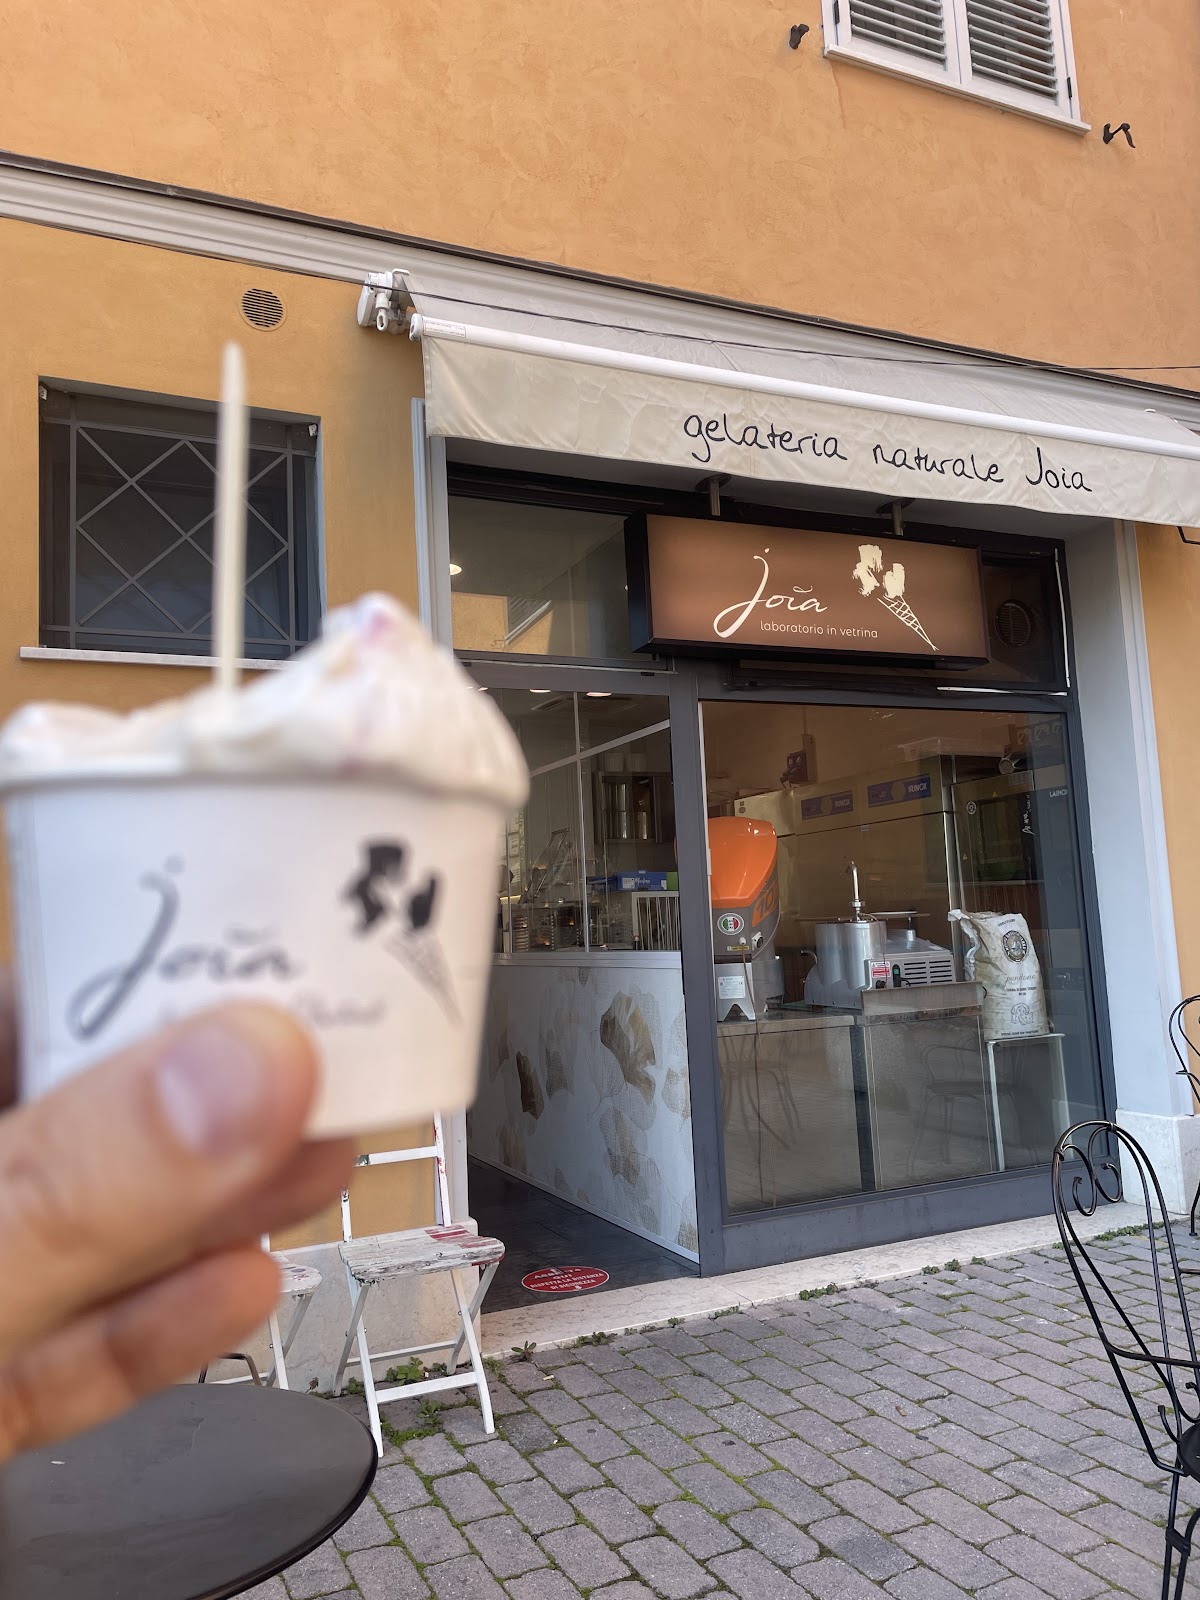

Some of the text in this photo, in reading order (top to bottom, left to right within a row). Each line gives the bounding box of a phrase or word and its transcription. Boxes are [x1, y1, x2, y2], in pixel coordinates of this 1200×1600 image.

[684, 413, 1092, 492] gelateria naturale Joia
[760, 620, 879, 638] laboratorio in vetrina
